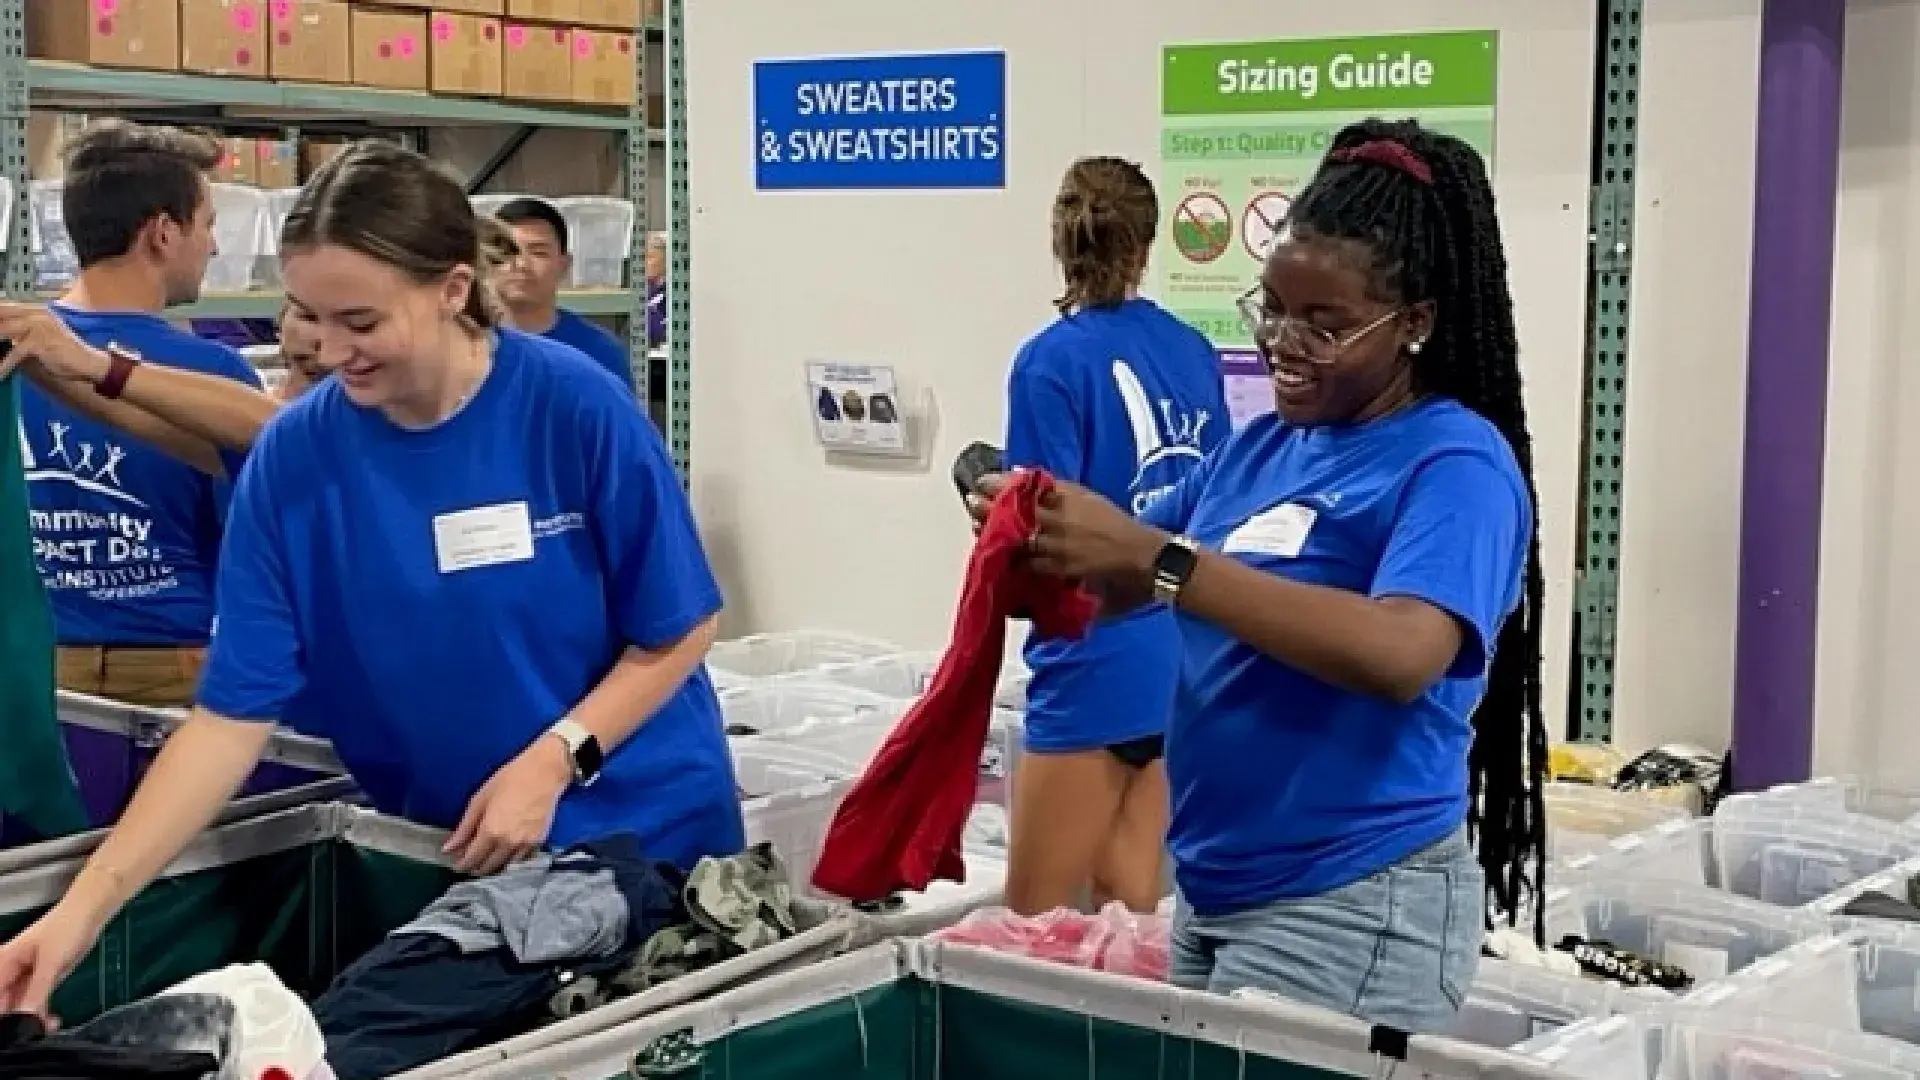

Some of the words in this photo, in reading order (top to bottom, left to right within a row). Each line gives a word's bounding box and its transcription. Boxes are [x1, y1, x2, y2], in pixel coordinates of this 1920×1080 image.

[1217, 57, 1318, 99] Sizing
[1328, 51, 1434, 88] Guide
[797, 77, 957, 115] SWEATERS
[761, 128, 781, 163] &
[787, 125, 1000, 163] SWEATSHIRTS
[1172, 131, 1213, 156] Step
[1237, 132, 1306, 157] Quality
[30, 509, 152, 540] mmunity
[33, 536, 97, 564] PACT
